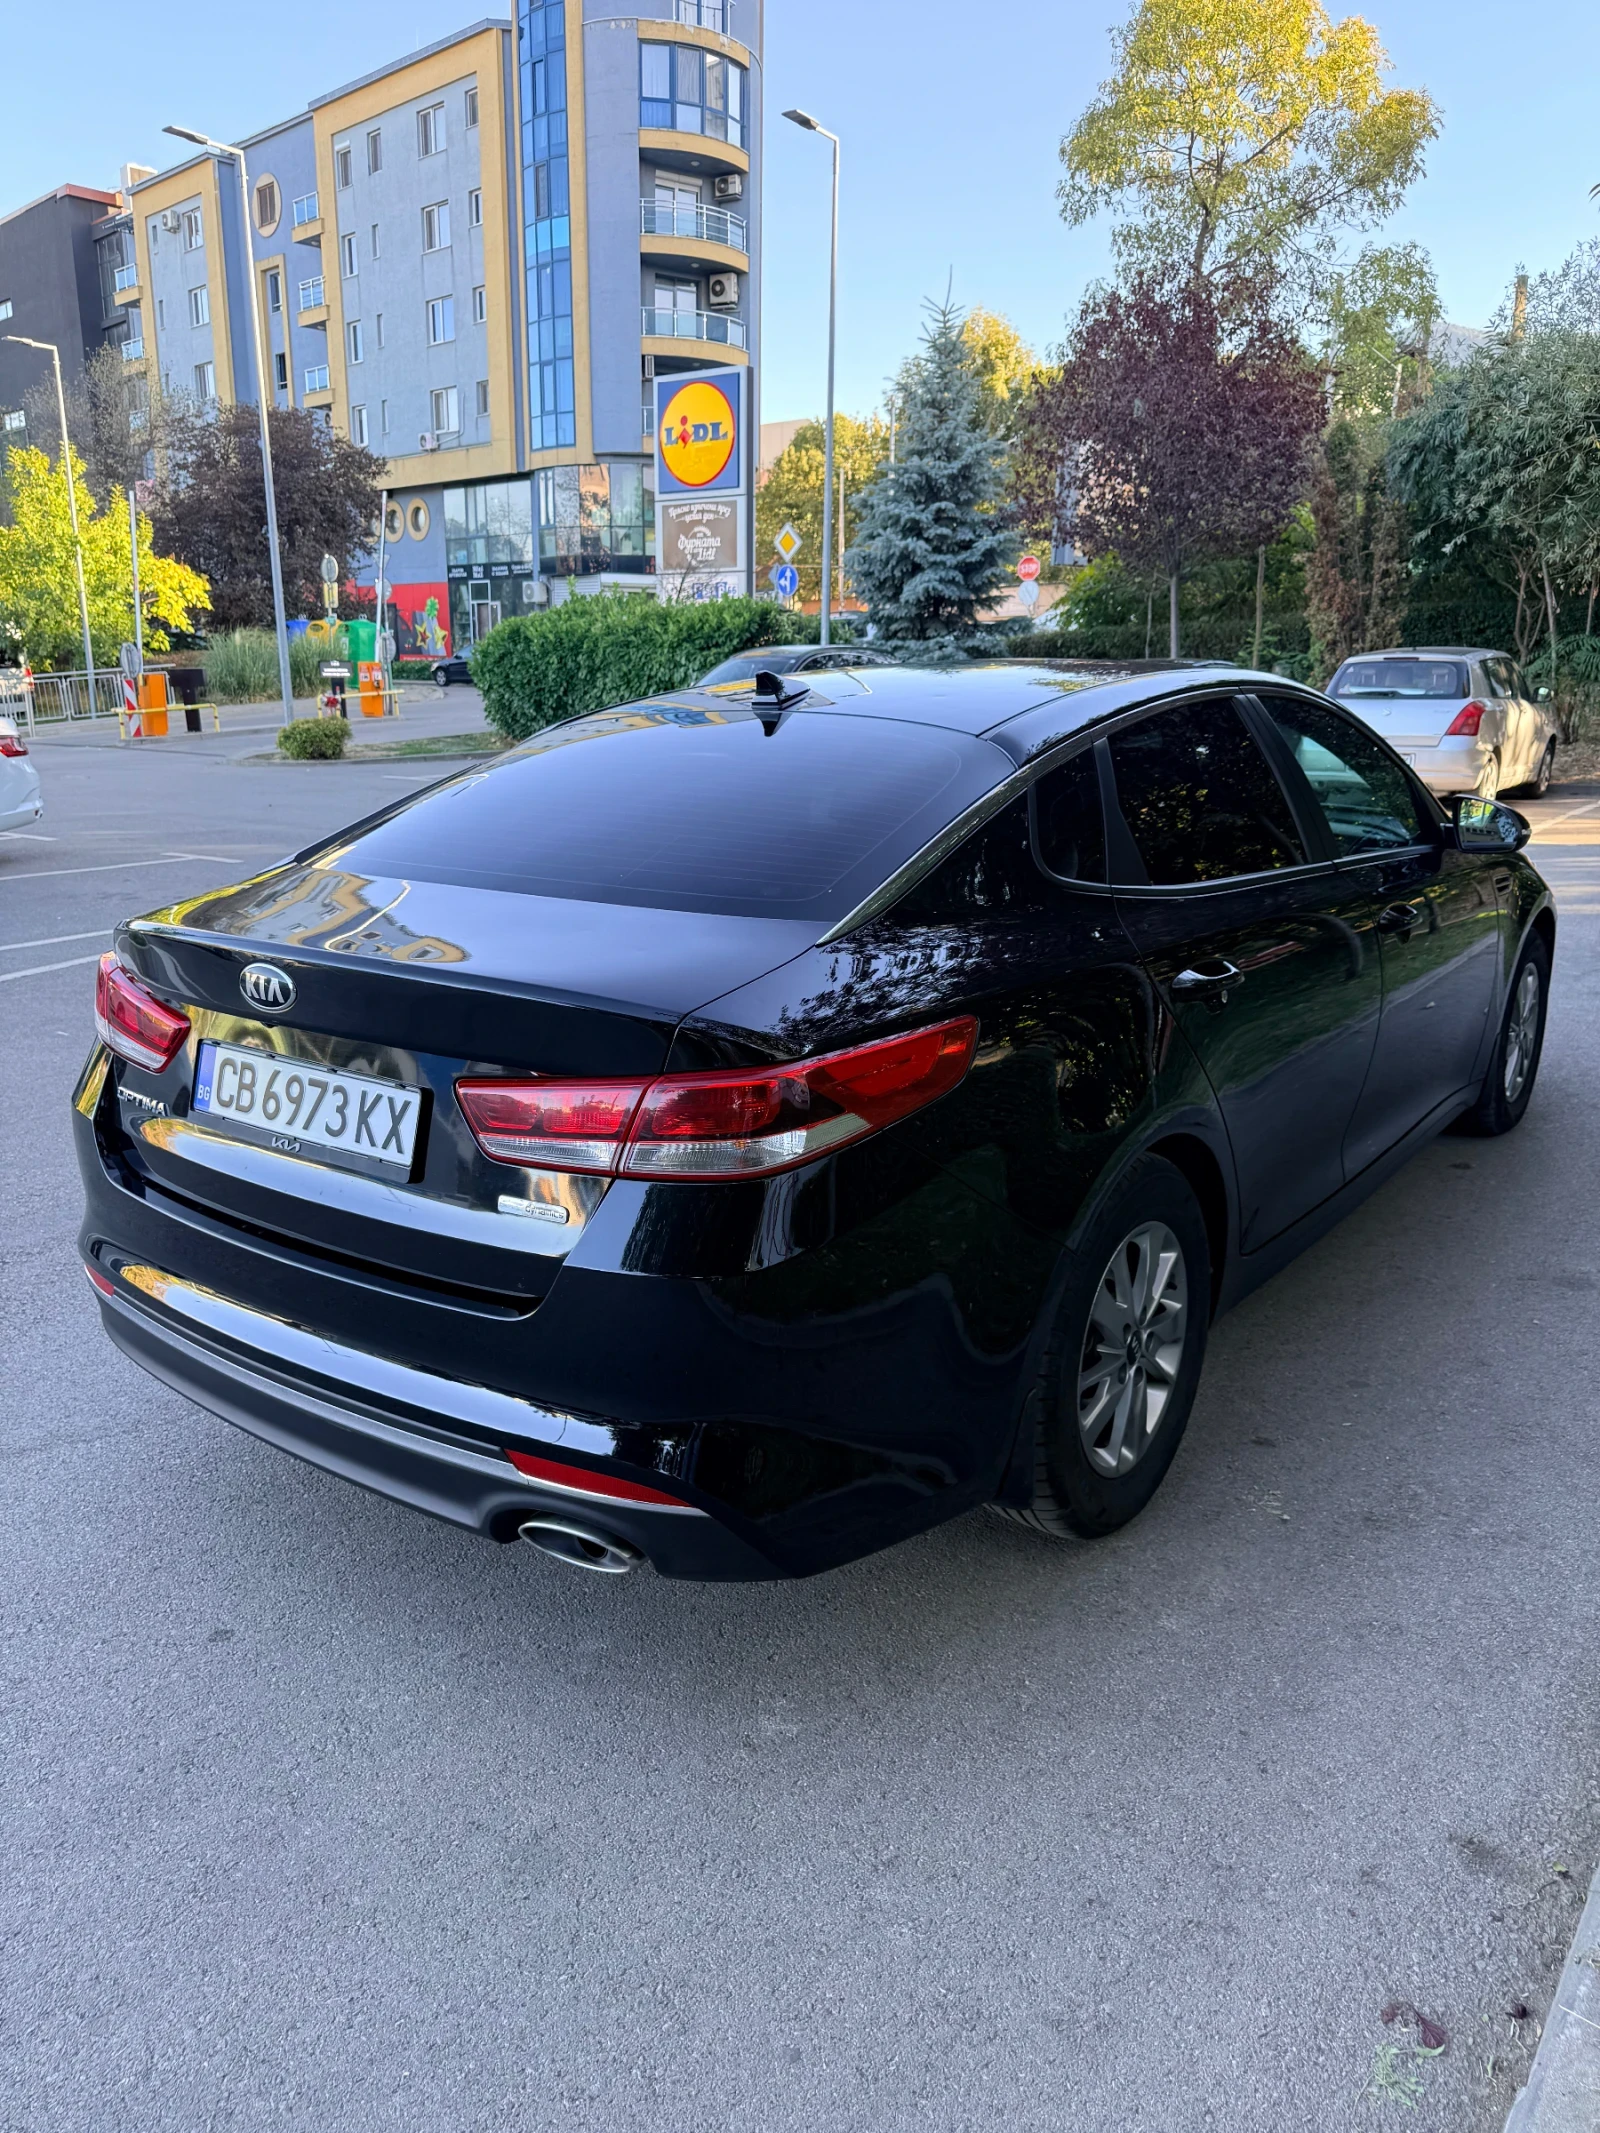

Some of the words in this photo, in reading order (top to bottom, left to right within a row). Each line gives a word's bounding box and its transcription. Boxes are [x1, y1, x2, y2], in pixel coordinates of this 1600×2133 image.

[678, 534, 721, 554] Фурната
[1020, 563, 1038, 573] STOP
[245, 972, 285, 1003] KIA
[117, 1086, 168, 1116] OPTIMA
[197, 1084, 211, 1101] BG
